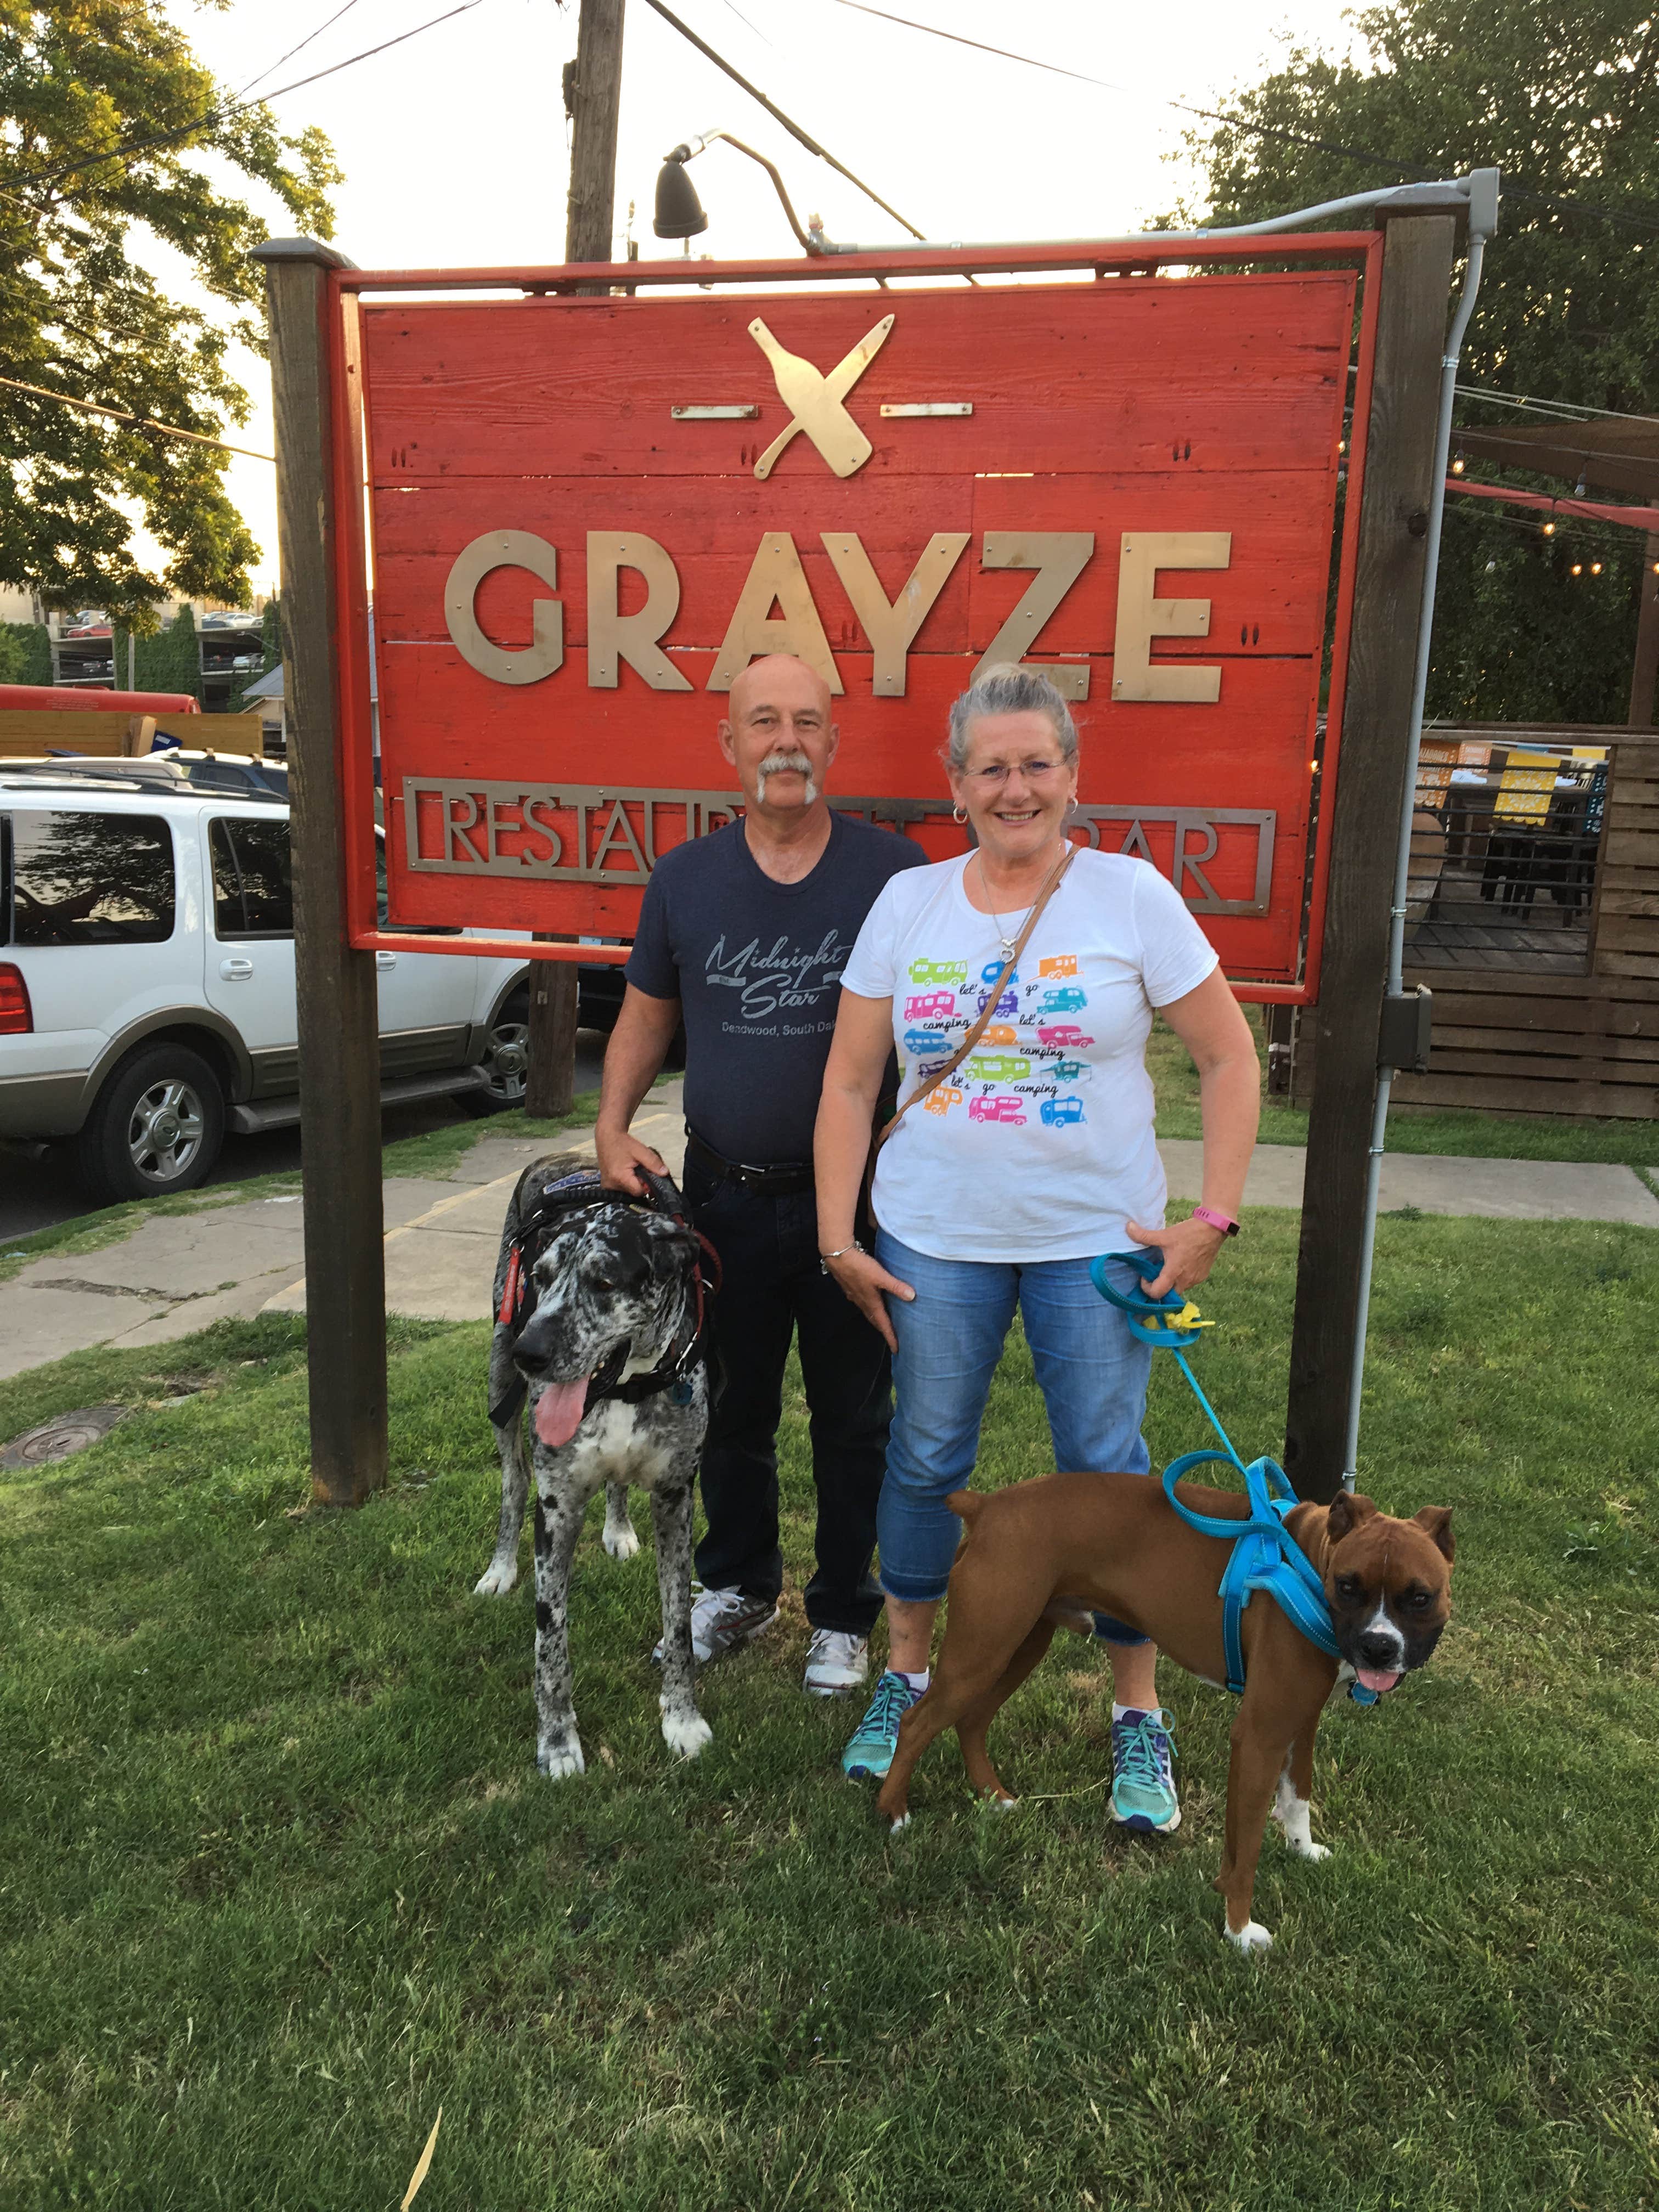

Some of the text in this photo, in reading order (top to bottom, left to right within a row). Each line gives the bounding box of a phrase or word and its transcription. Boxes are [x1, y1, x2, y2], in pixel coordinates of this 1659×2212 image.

[444, 529, 1232, 703] GRAYZE
[442, 792, 926, 873] RESTAU
[704, 929, 854, 989] Midnight
[741, 973, 832, 1019] Star
[960, 984, 1039, 997] let's go
[722, 1022, 780, 1037] Deadwood,
[782, 1023, 815, 1036] South
[923, 1014, 1045, 1032] camping let's
[1020, 1048, 1065, 1061] camping
[951, 1075, 1058, 1098] let's go camping
